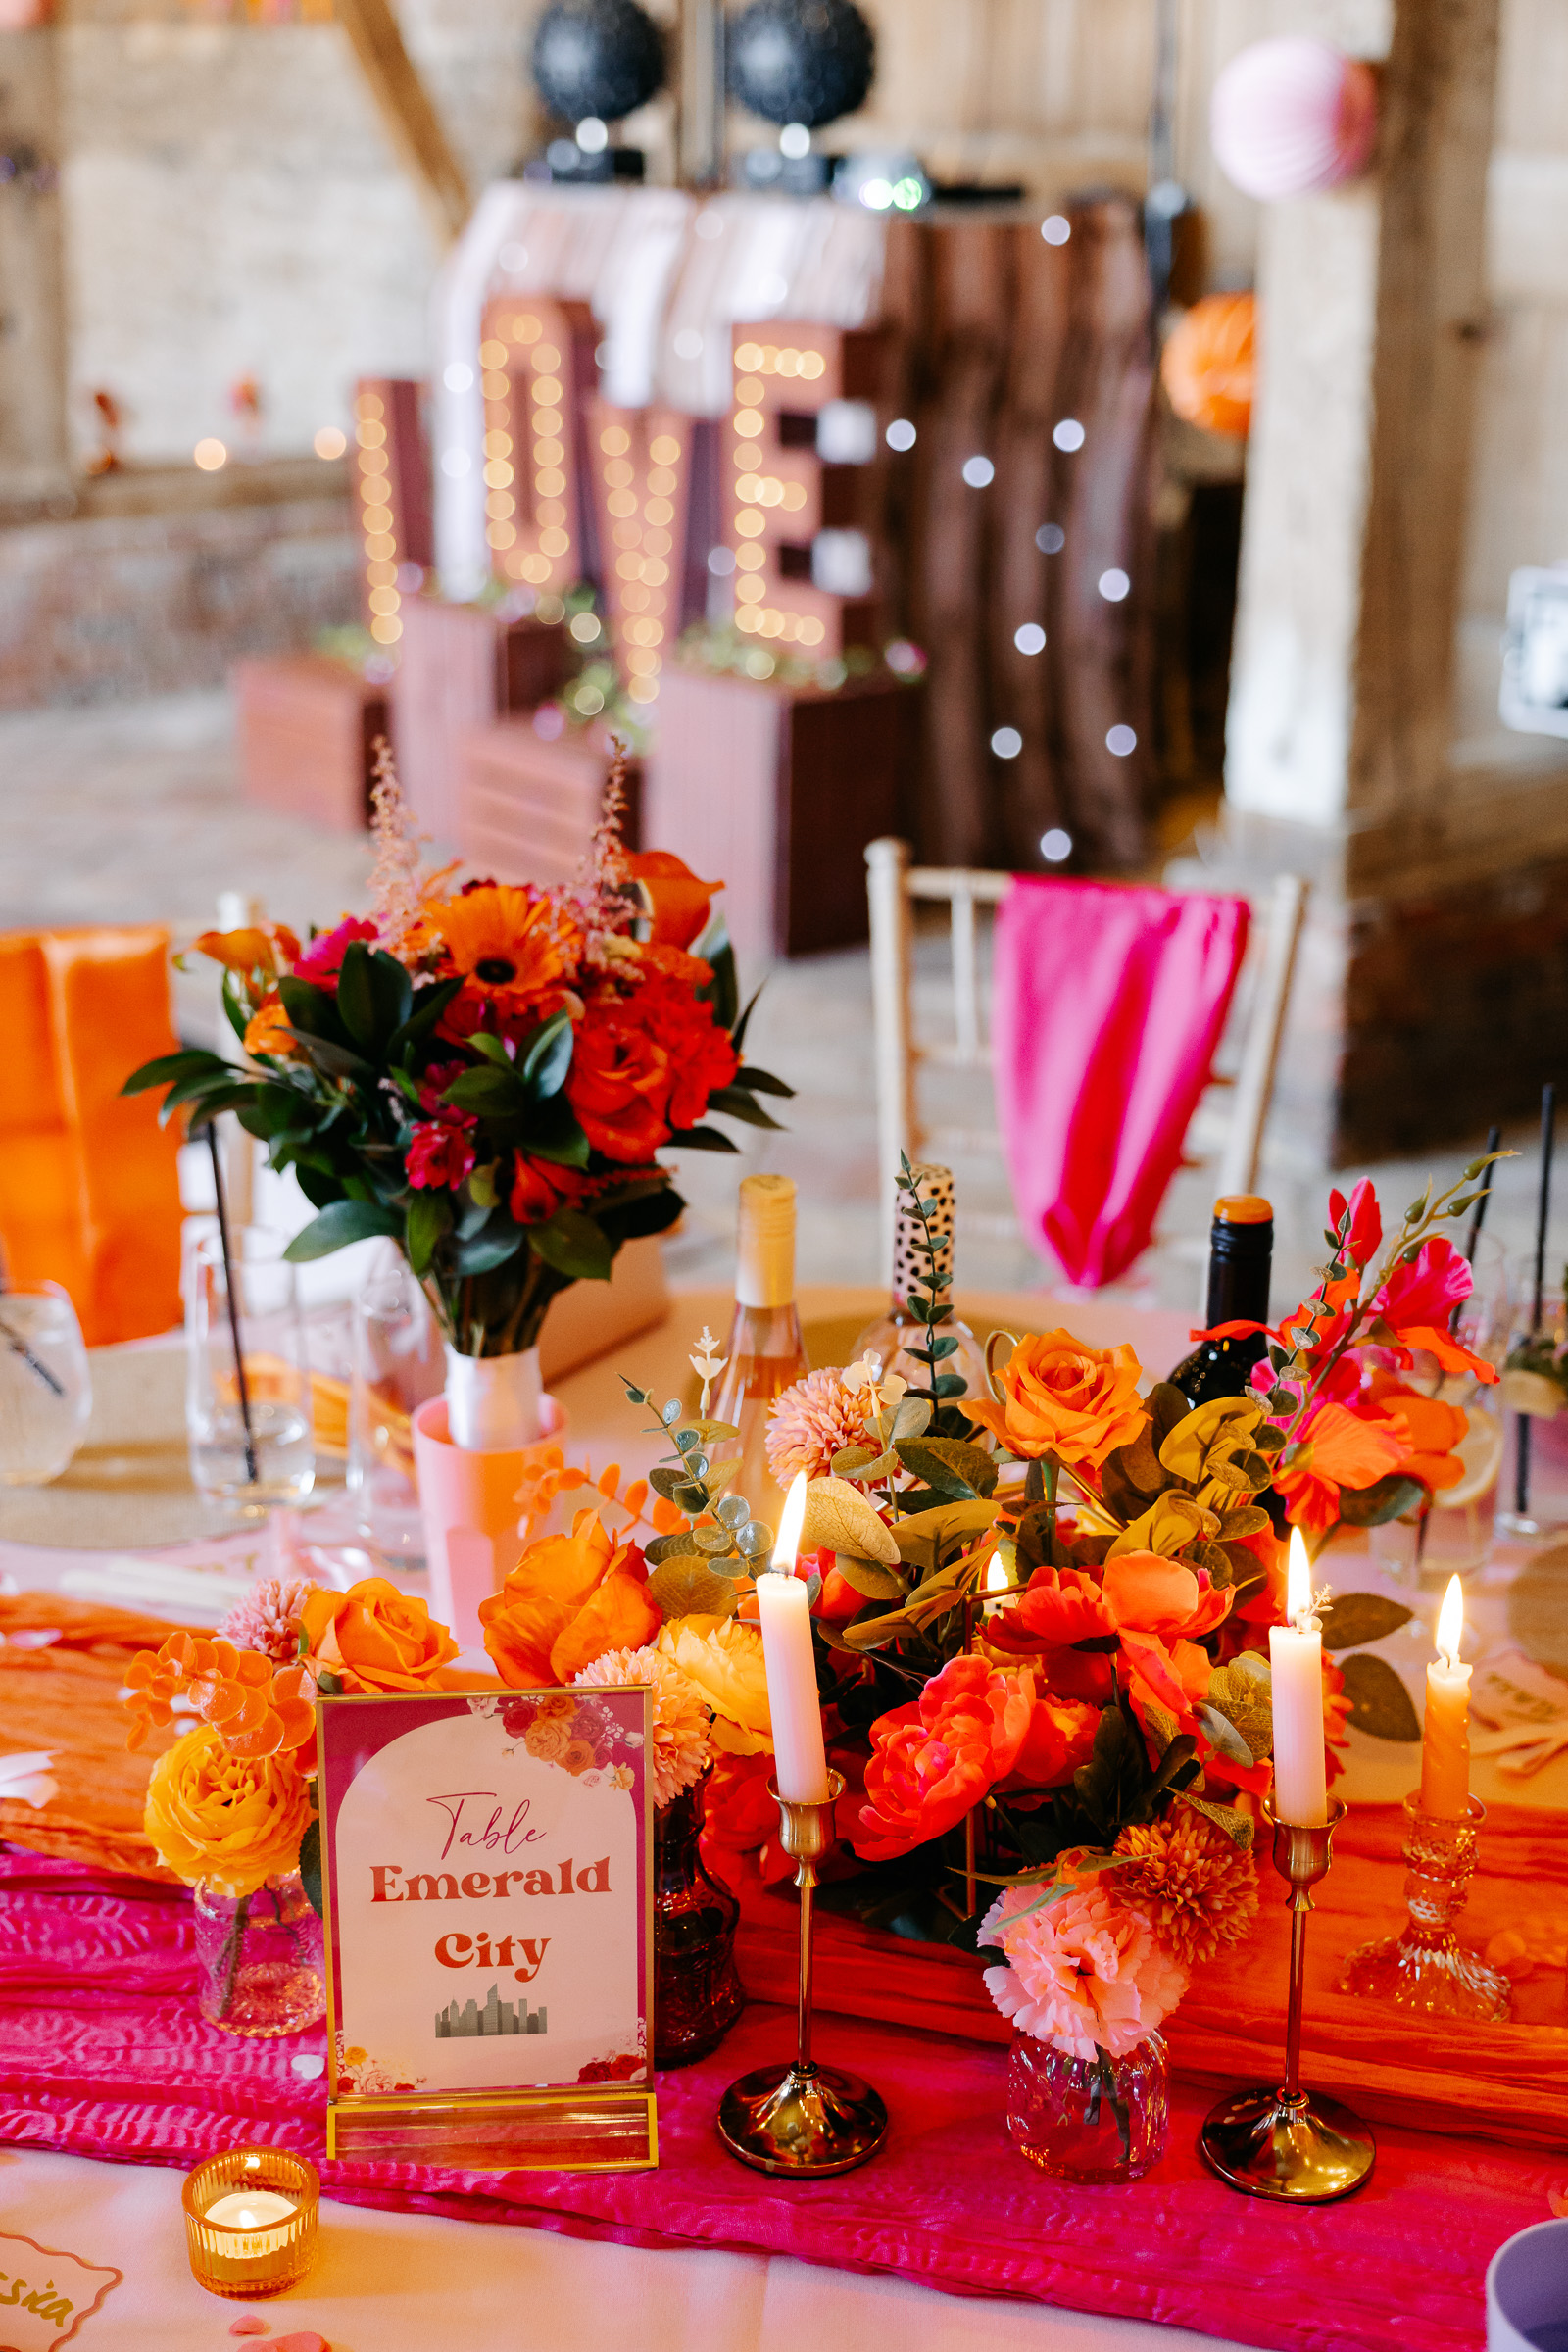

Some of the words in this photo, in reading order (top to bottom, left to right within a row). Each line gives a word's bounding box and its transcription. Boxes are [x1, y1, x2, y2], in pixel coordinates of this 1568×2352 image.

[426, 1792, 547, 1860] Table
[369, 1856, 612, 1903] Emerald
[434, 1932, 552, 1984] City
